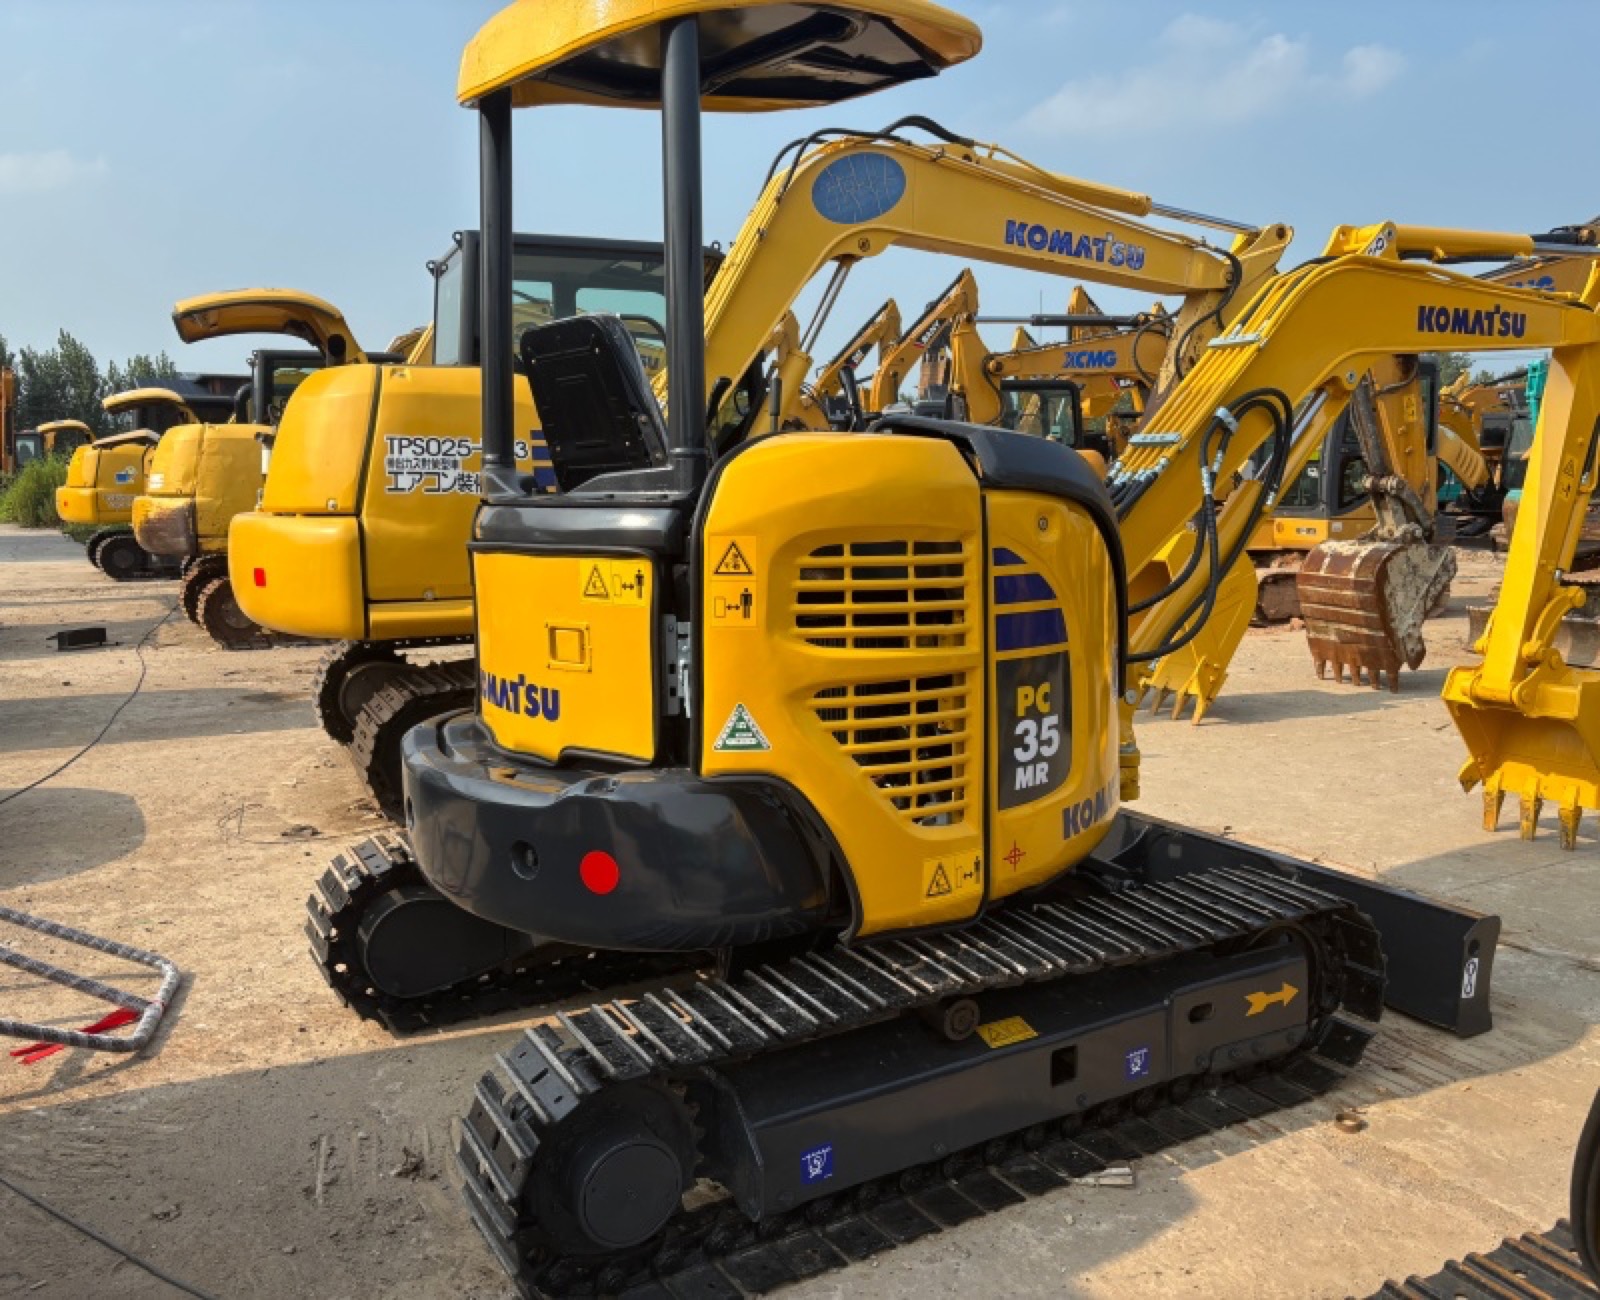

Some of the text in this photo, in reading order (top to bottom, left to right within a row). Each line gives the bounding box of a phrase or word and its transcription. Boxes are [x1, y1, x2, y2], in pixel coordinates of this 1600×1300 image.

[1005, 219, 1146, 271] KOMATSU
[1417, 304, 1527, 338] KOMATSU
[1063, 350, 1117, 369] XCMG
[481, 670, 560, 722] MATSU
[1016, 682, 1051, 717] PC
[1013, 714, 1060, 763] 35
[1014, 762, 1049, 791] MR
